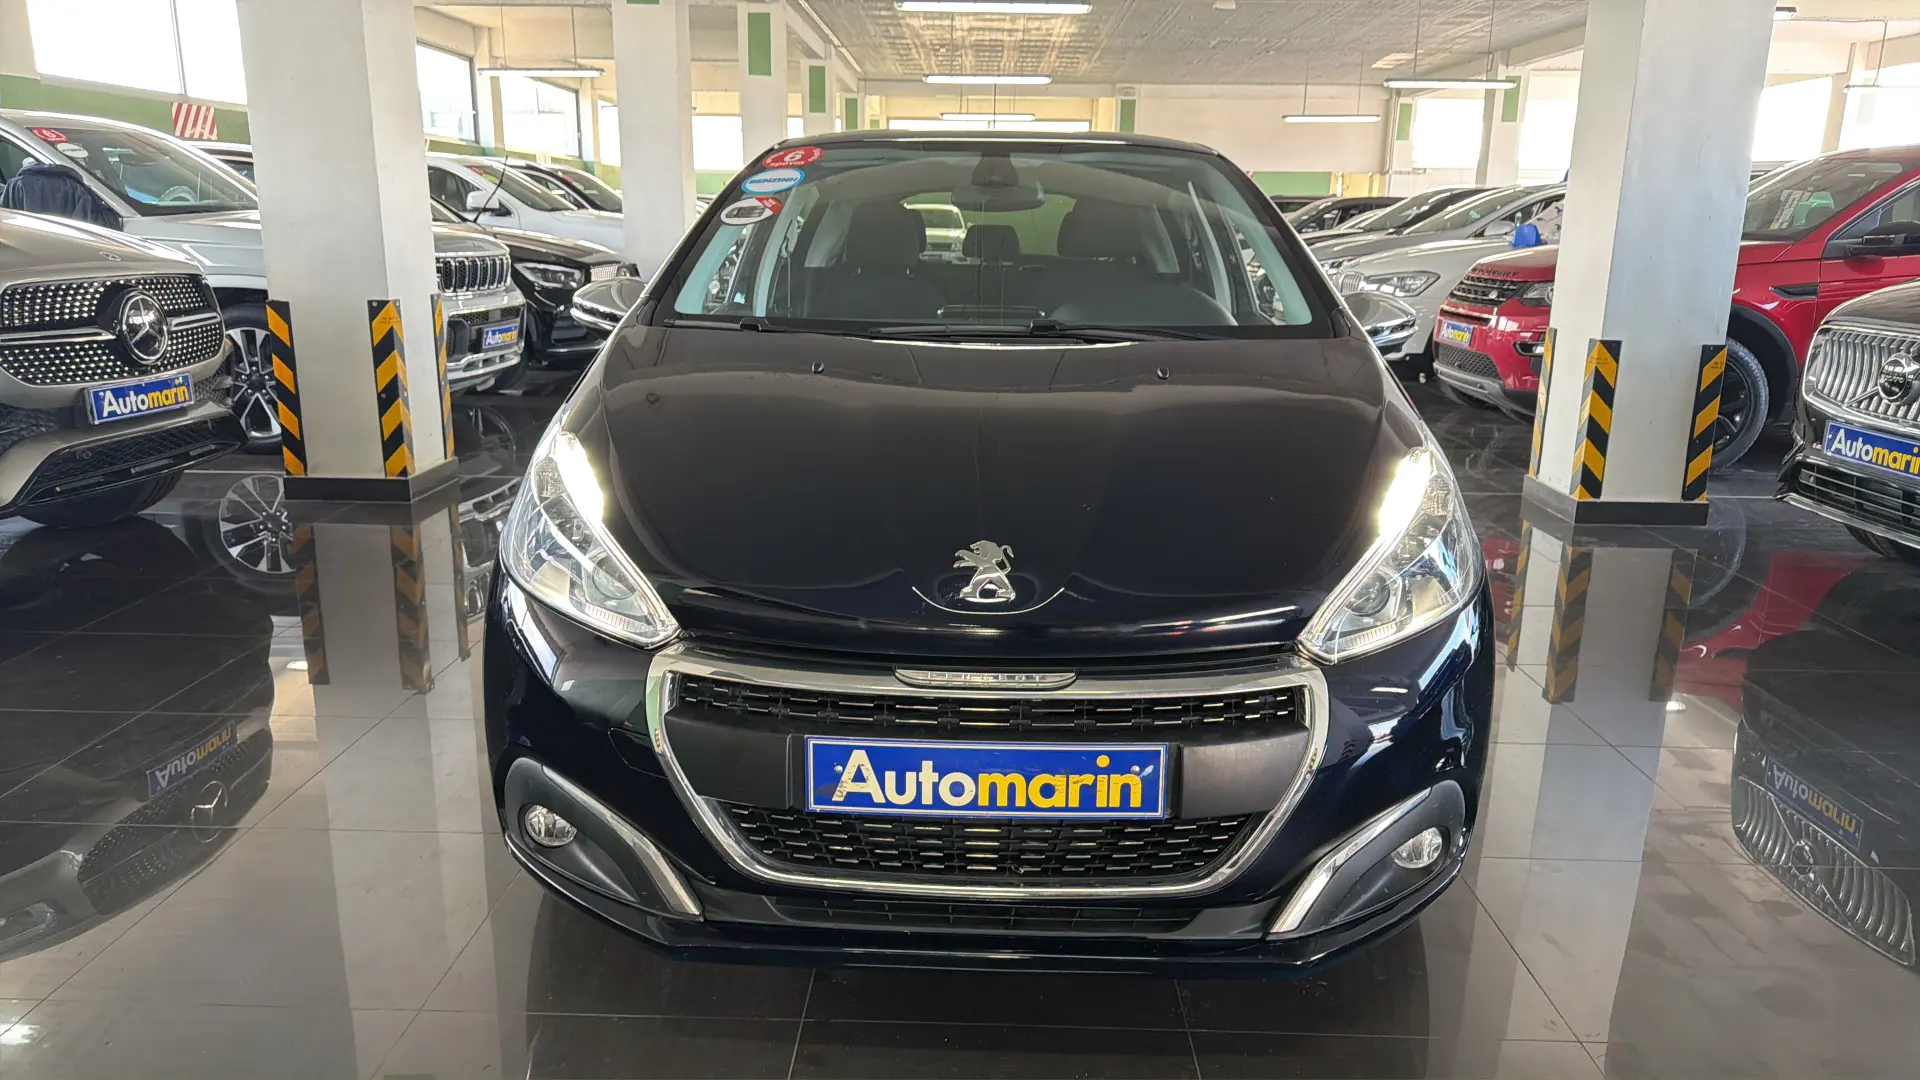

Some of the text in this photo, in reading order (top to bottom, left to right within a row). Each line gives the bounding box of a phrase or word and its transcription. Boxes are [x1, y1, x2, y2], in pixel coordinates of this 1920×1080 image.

[783, 150, 805, 162] 6
[102, 379, 189, 417] Automarin
[832, 749, 1142, 808] Automarin
